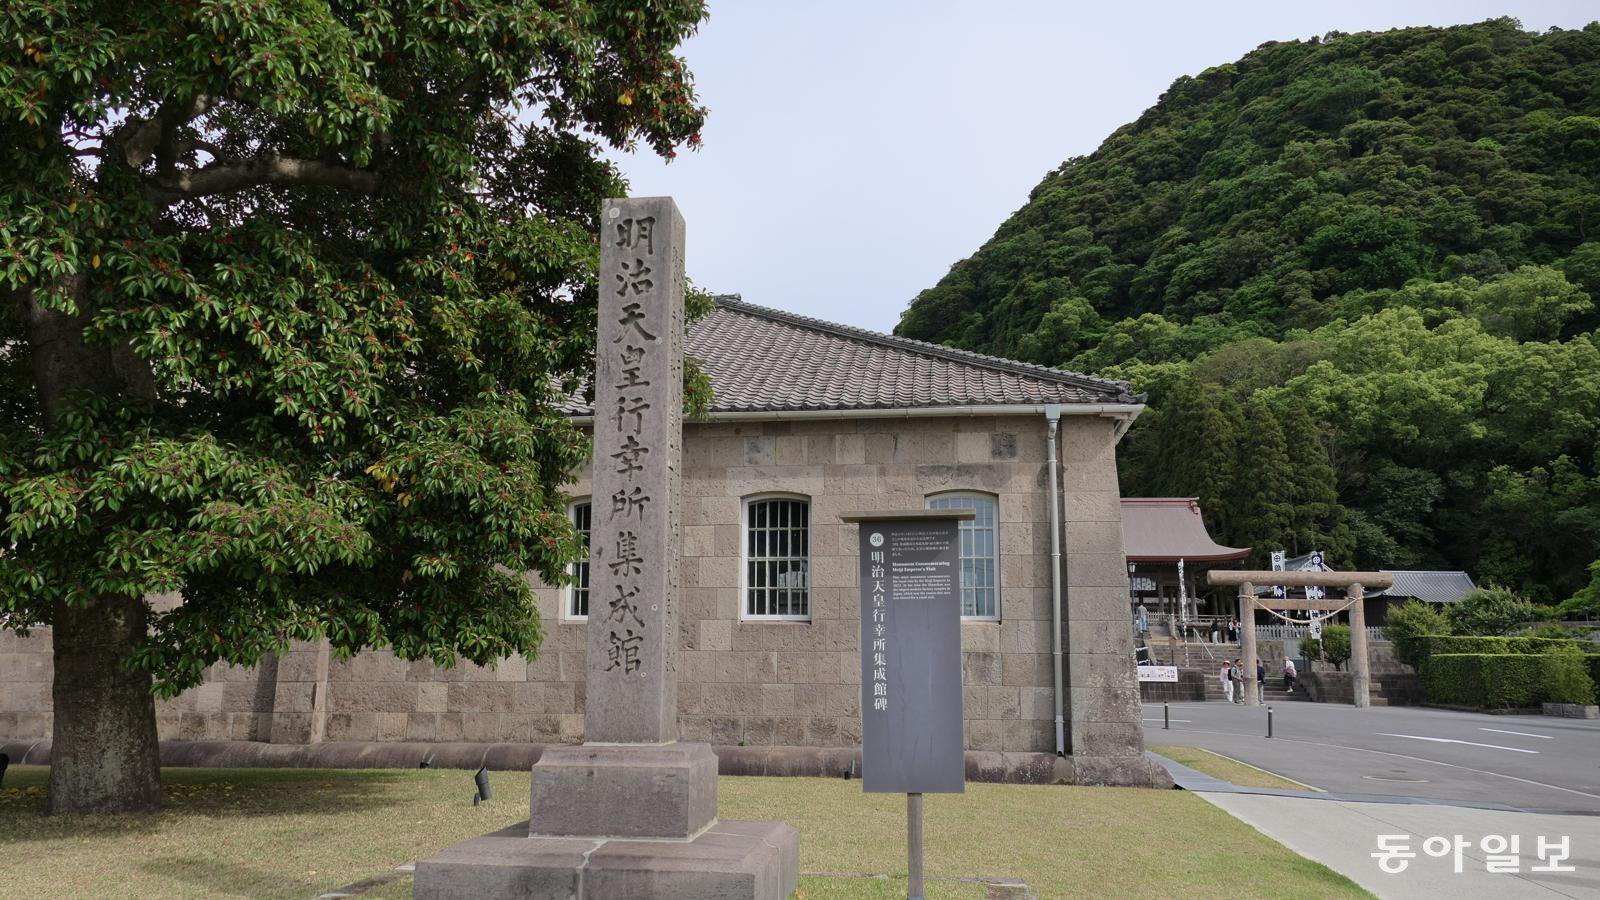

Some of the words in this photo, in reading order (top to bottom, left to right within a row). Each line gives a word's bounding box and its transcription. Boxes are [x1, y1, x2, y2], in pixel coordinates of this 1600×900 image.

[603, 215, 656, 675] 明治天皇行幸所集成館
[871, 551, 888, 711] 明治天皇行幸所集成館碑
